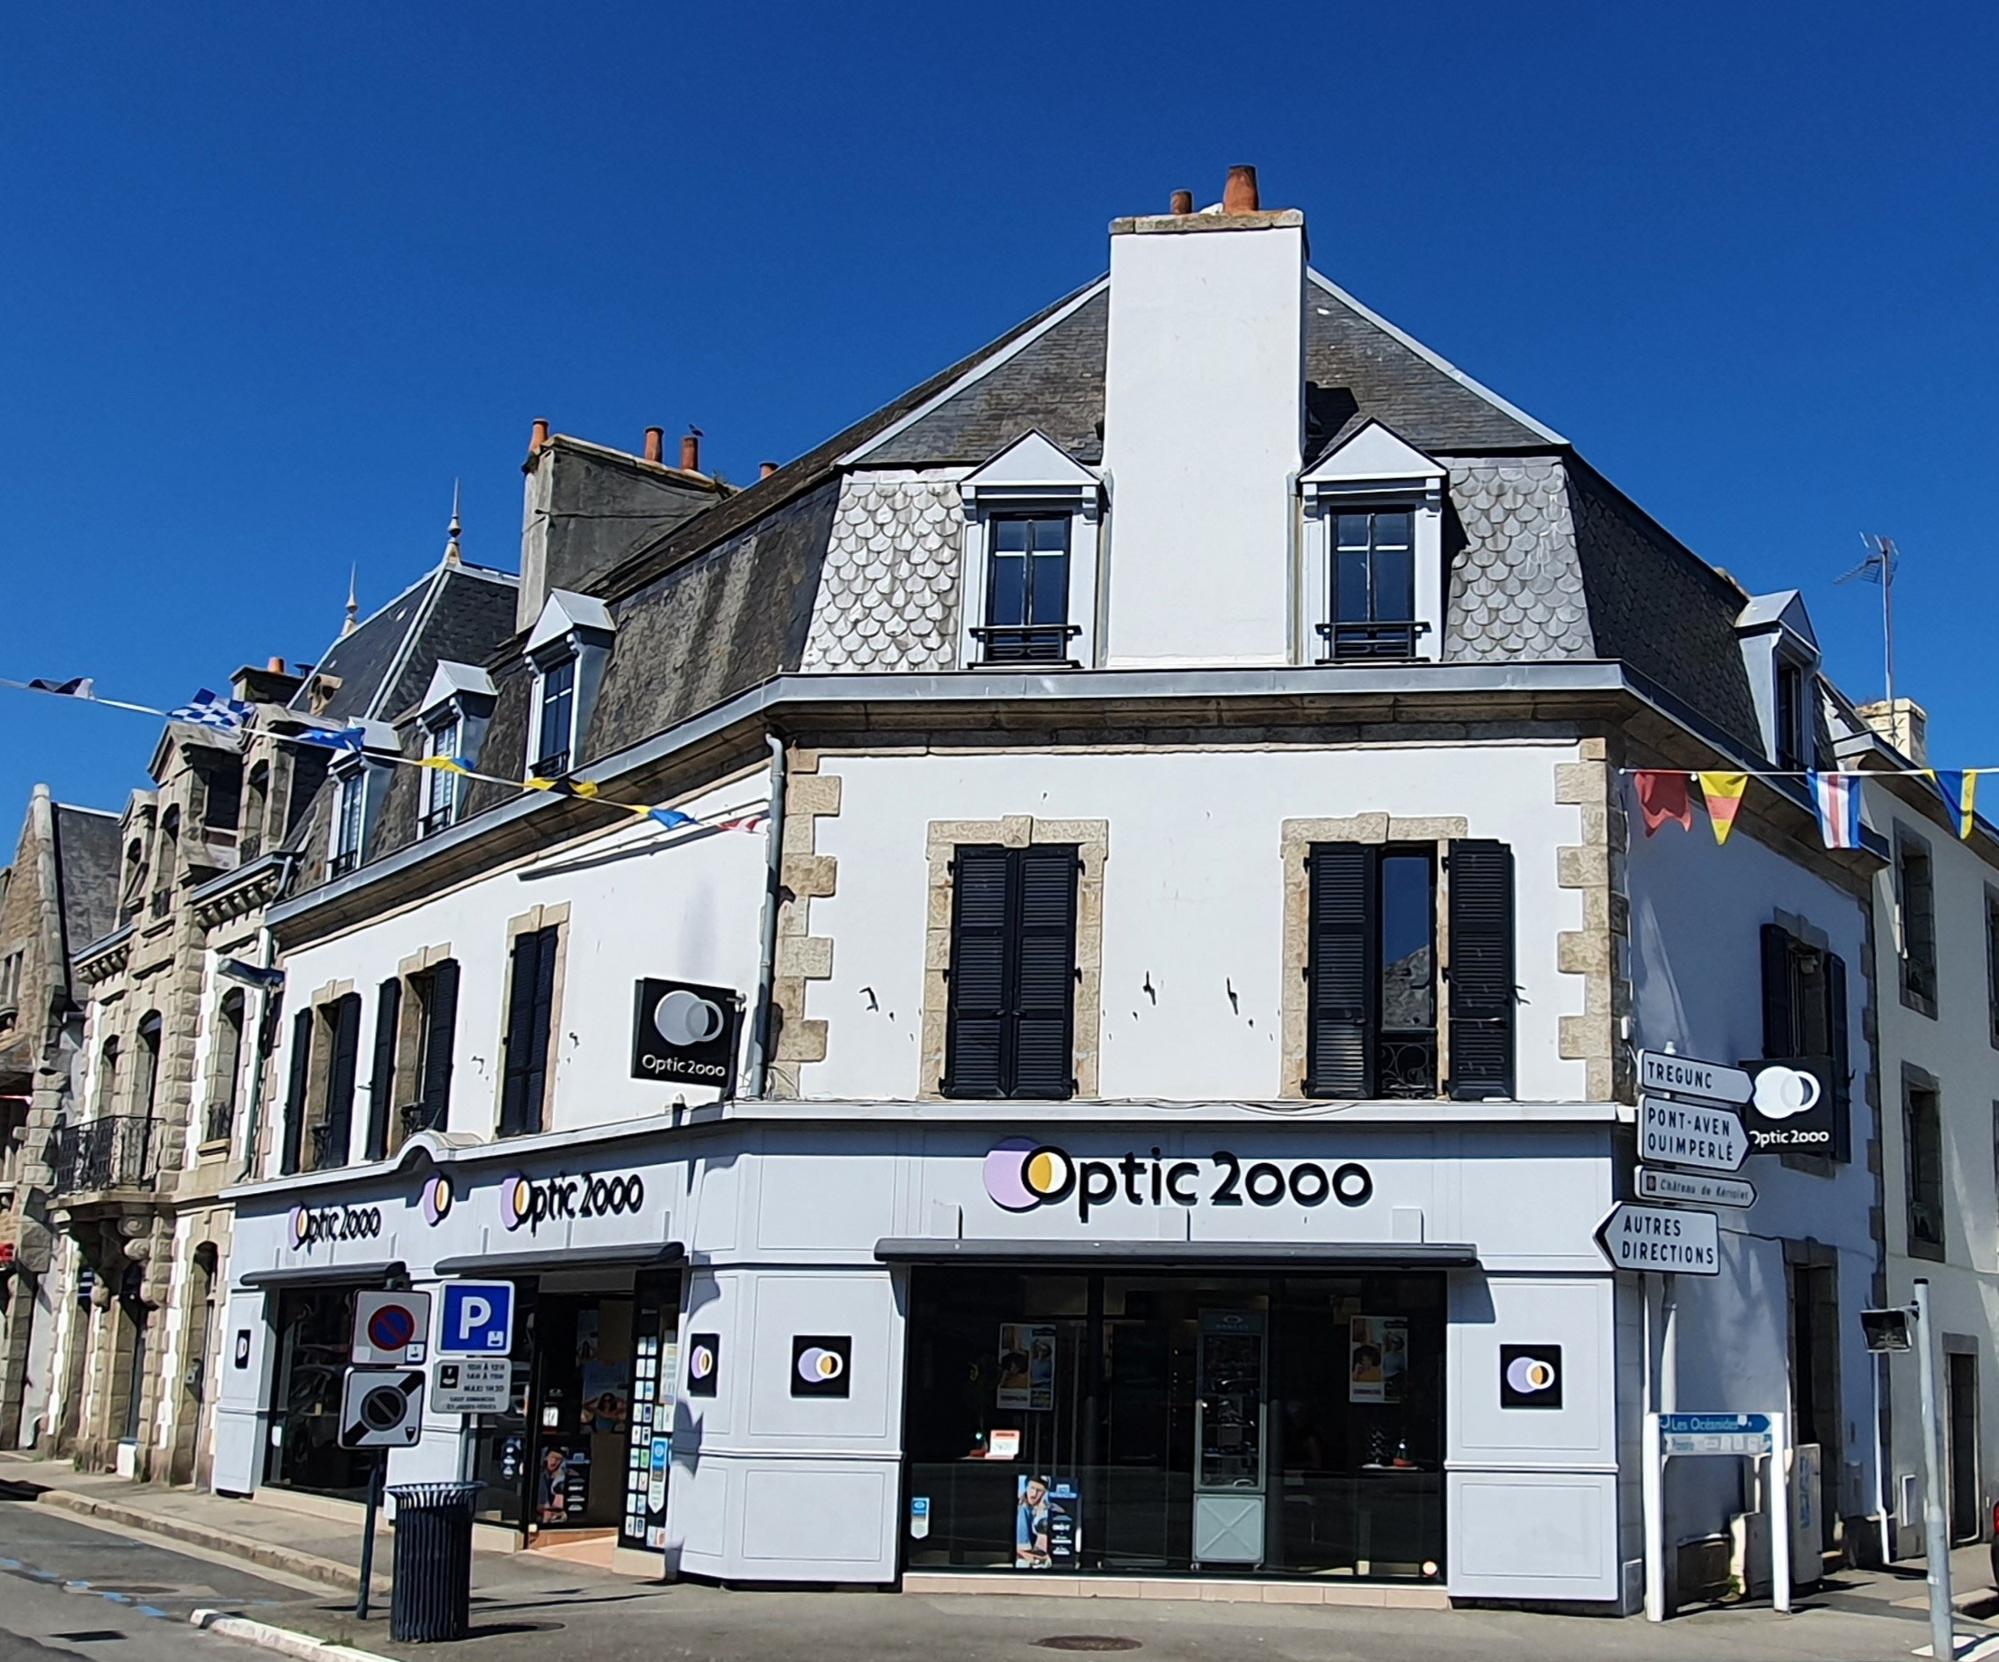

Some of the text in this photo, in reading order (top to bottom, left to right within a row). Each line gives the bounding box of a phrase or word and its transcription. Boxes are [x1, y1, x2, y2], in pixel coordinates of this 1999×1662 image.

[642, 1054, 726, 1077] Optic 2000
[1647, 1061, 1713, 1090] TREGUNC
[1647, 1108, 1730, 1137] PONT-AVEN
[1791, 1130, 1830, 1144] 2000
[1021, 1145, 1373, 1223] Optic 2000
[1701, 1184, 1711, 1196] de
[512, 1170, 645, 1238] Optic 2000
[295, 1202, 382, 1256] Optic 2000
[1623, 1215, 1681, 1237] AUTRES
[1622, 1242, 1714, 1265] DIRECTIONS
[459, 1296, 492, 1340] P
[1671, 1418, 1688, 1431] Les
